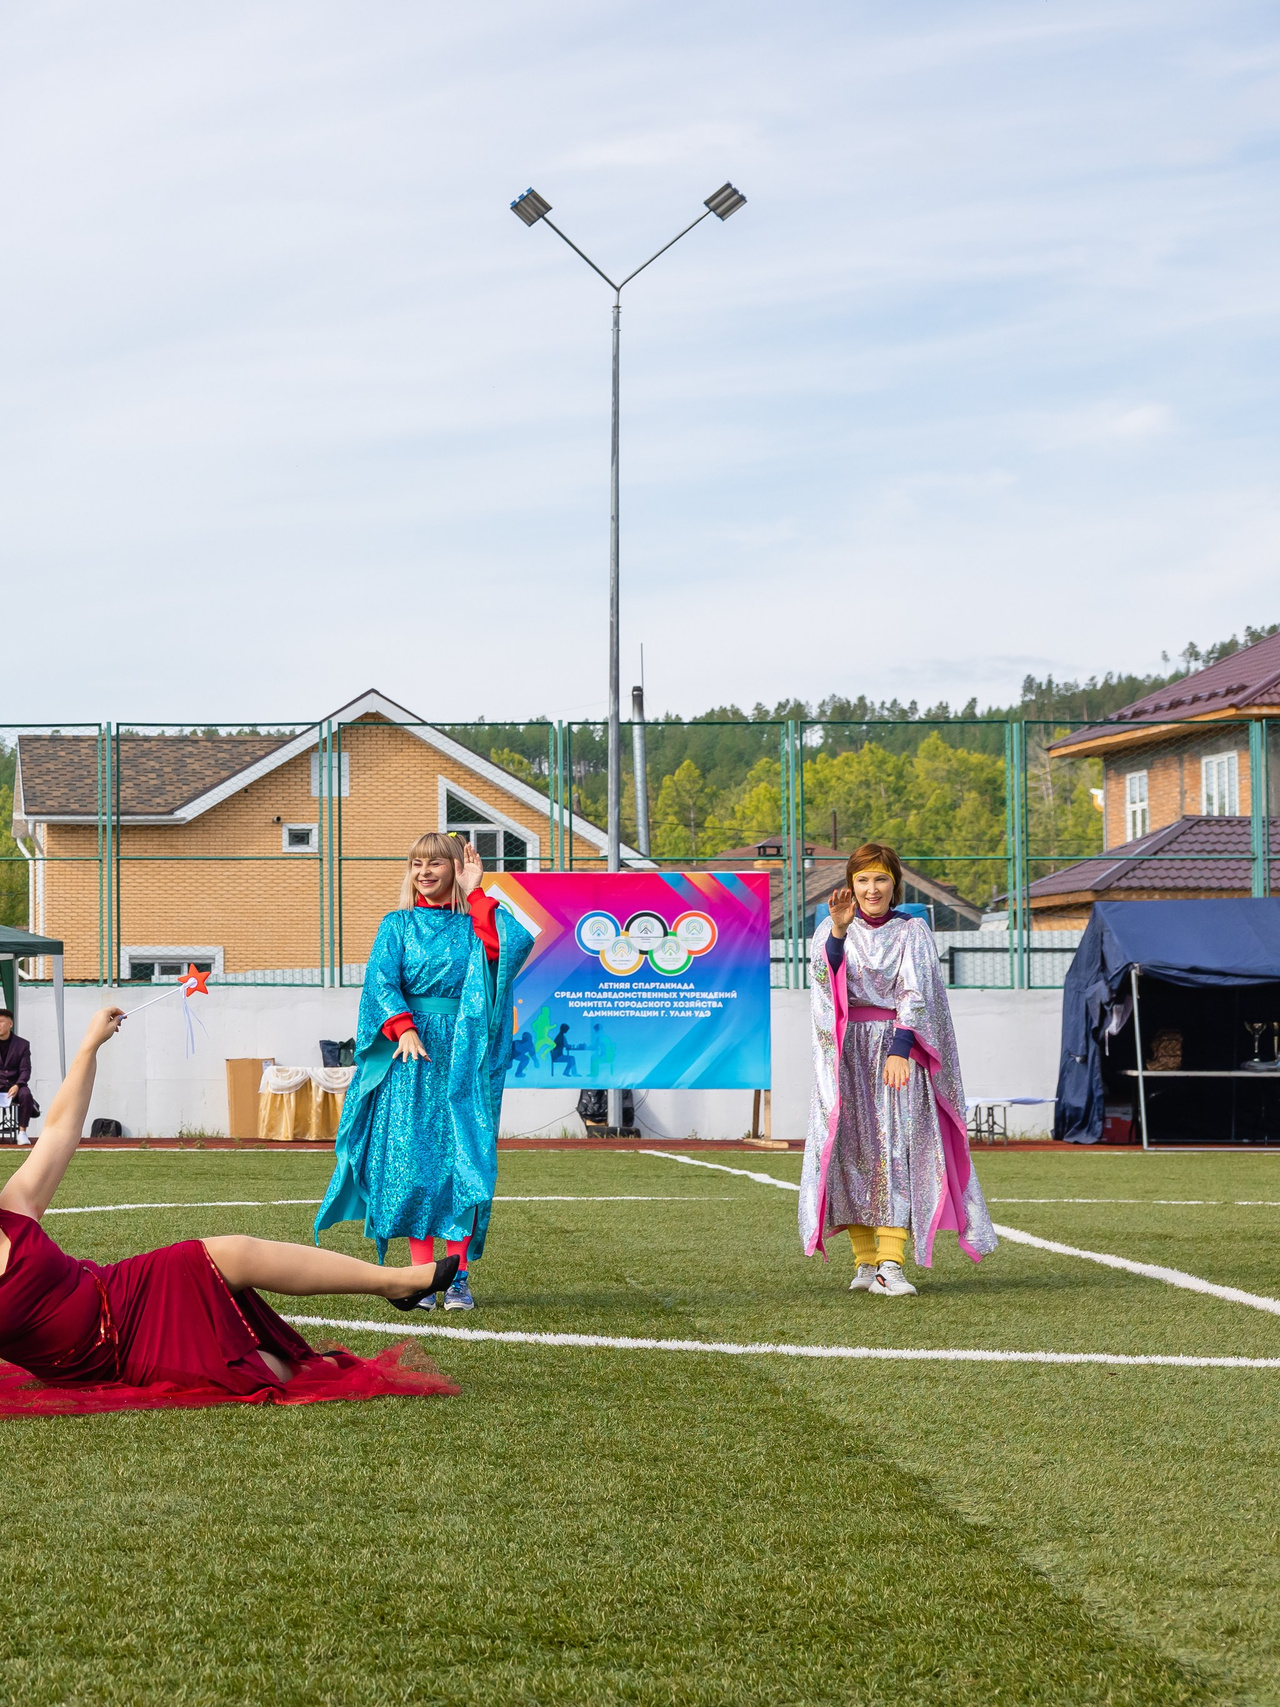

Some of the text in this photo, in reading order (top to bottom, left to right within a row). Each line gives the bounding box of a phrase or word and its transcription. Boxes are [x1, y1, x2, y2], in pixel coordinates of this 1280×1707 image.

[598, 982, 695, 990] ЛЕТНЯЯ СПАРТАКИАДА
[554, 990, 737, 999] СРЕДИ ПОДВЕДОМСТВЕННЫХ УЧРЕЖДЕНИЙ
[672, 999, 723, 1008] ХОЗЯЙСТВА
[582, 1010, 712, 1018] АДМИНИСТРАЦИИ Г. УЛАН-УДЭ
